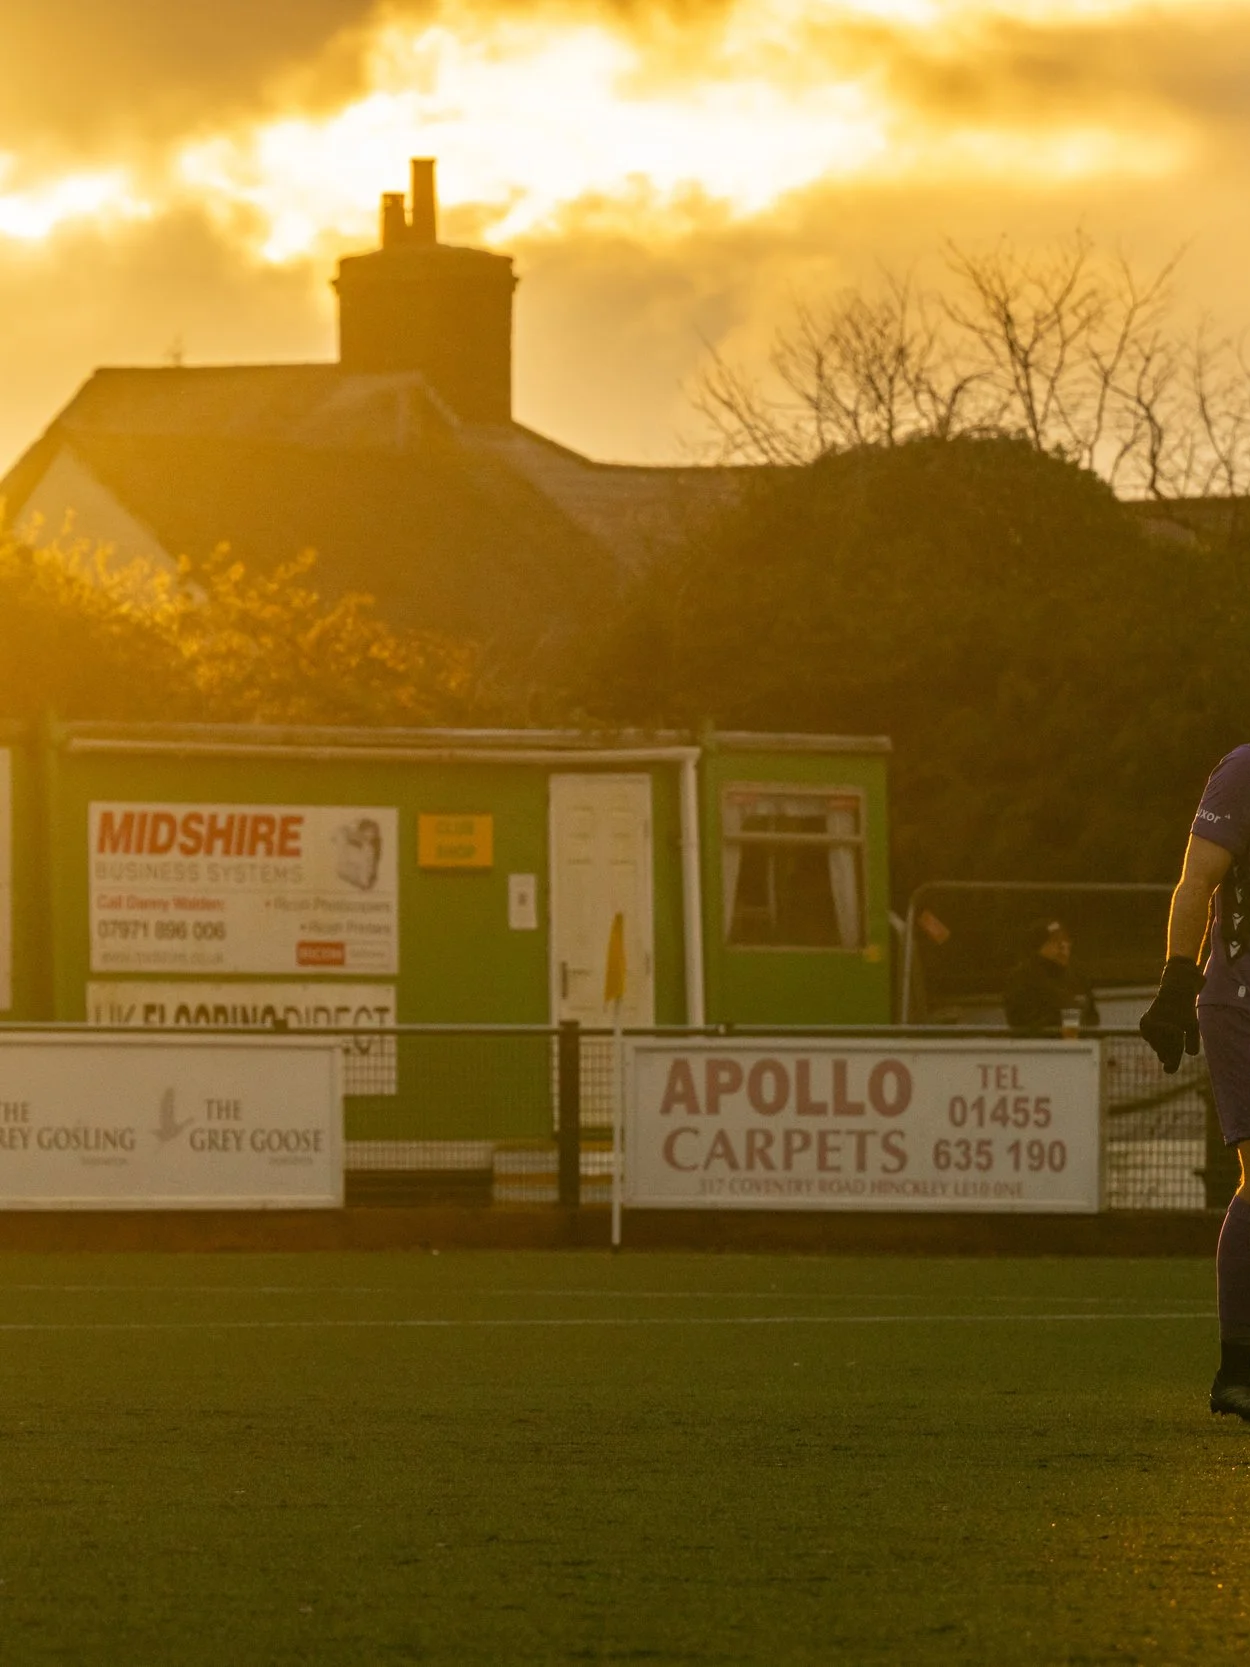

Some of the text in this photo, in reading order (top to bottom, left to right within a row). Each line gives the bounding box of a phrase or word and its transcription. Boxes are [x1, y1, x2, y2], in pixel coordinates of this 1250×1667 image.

[97, 811, 305, 857] MIDSHIRE
[95, 861, 304, 884] BUSINESS SYSTEMS
[659, 1058, 913, 1118] APOLLO
[977, 1063, 1025, 1091] TEL
[204, 1098, 243, 1121] THE
[948, 1096, 1053, 1129] 01455
[0, 1126, 137, 1152] REY GOSLING
[189, 1127, 325, 1153] GREY GOOSE
[662, 1127, 910, 1174] CARPETS
[932, 1138, 1068, 1174] 635 190
[818, 1179, 865, 1196] ROAD
[870, 1179, 948, 1196] HINCKLEY
